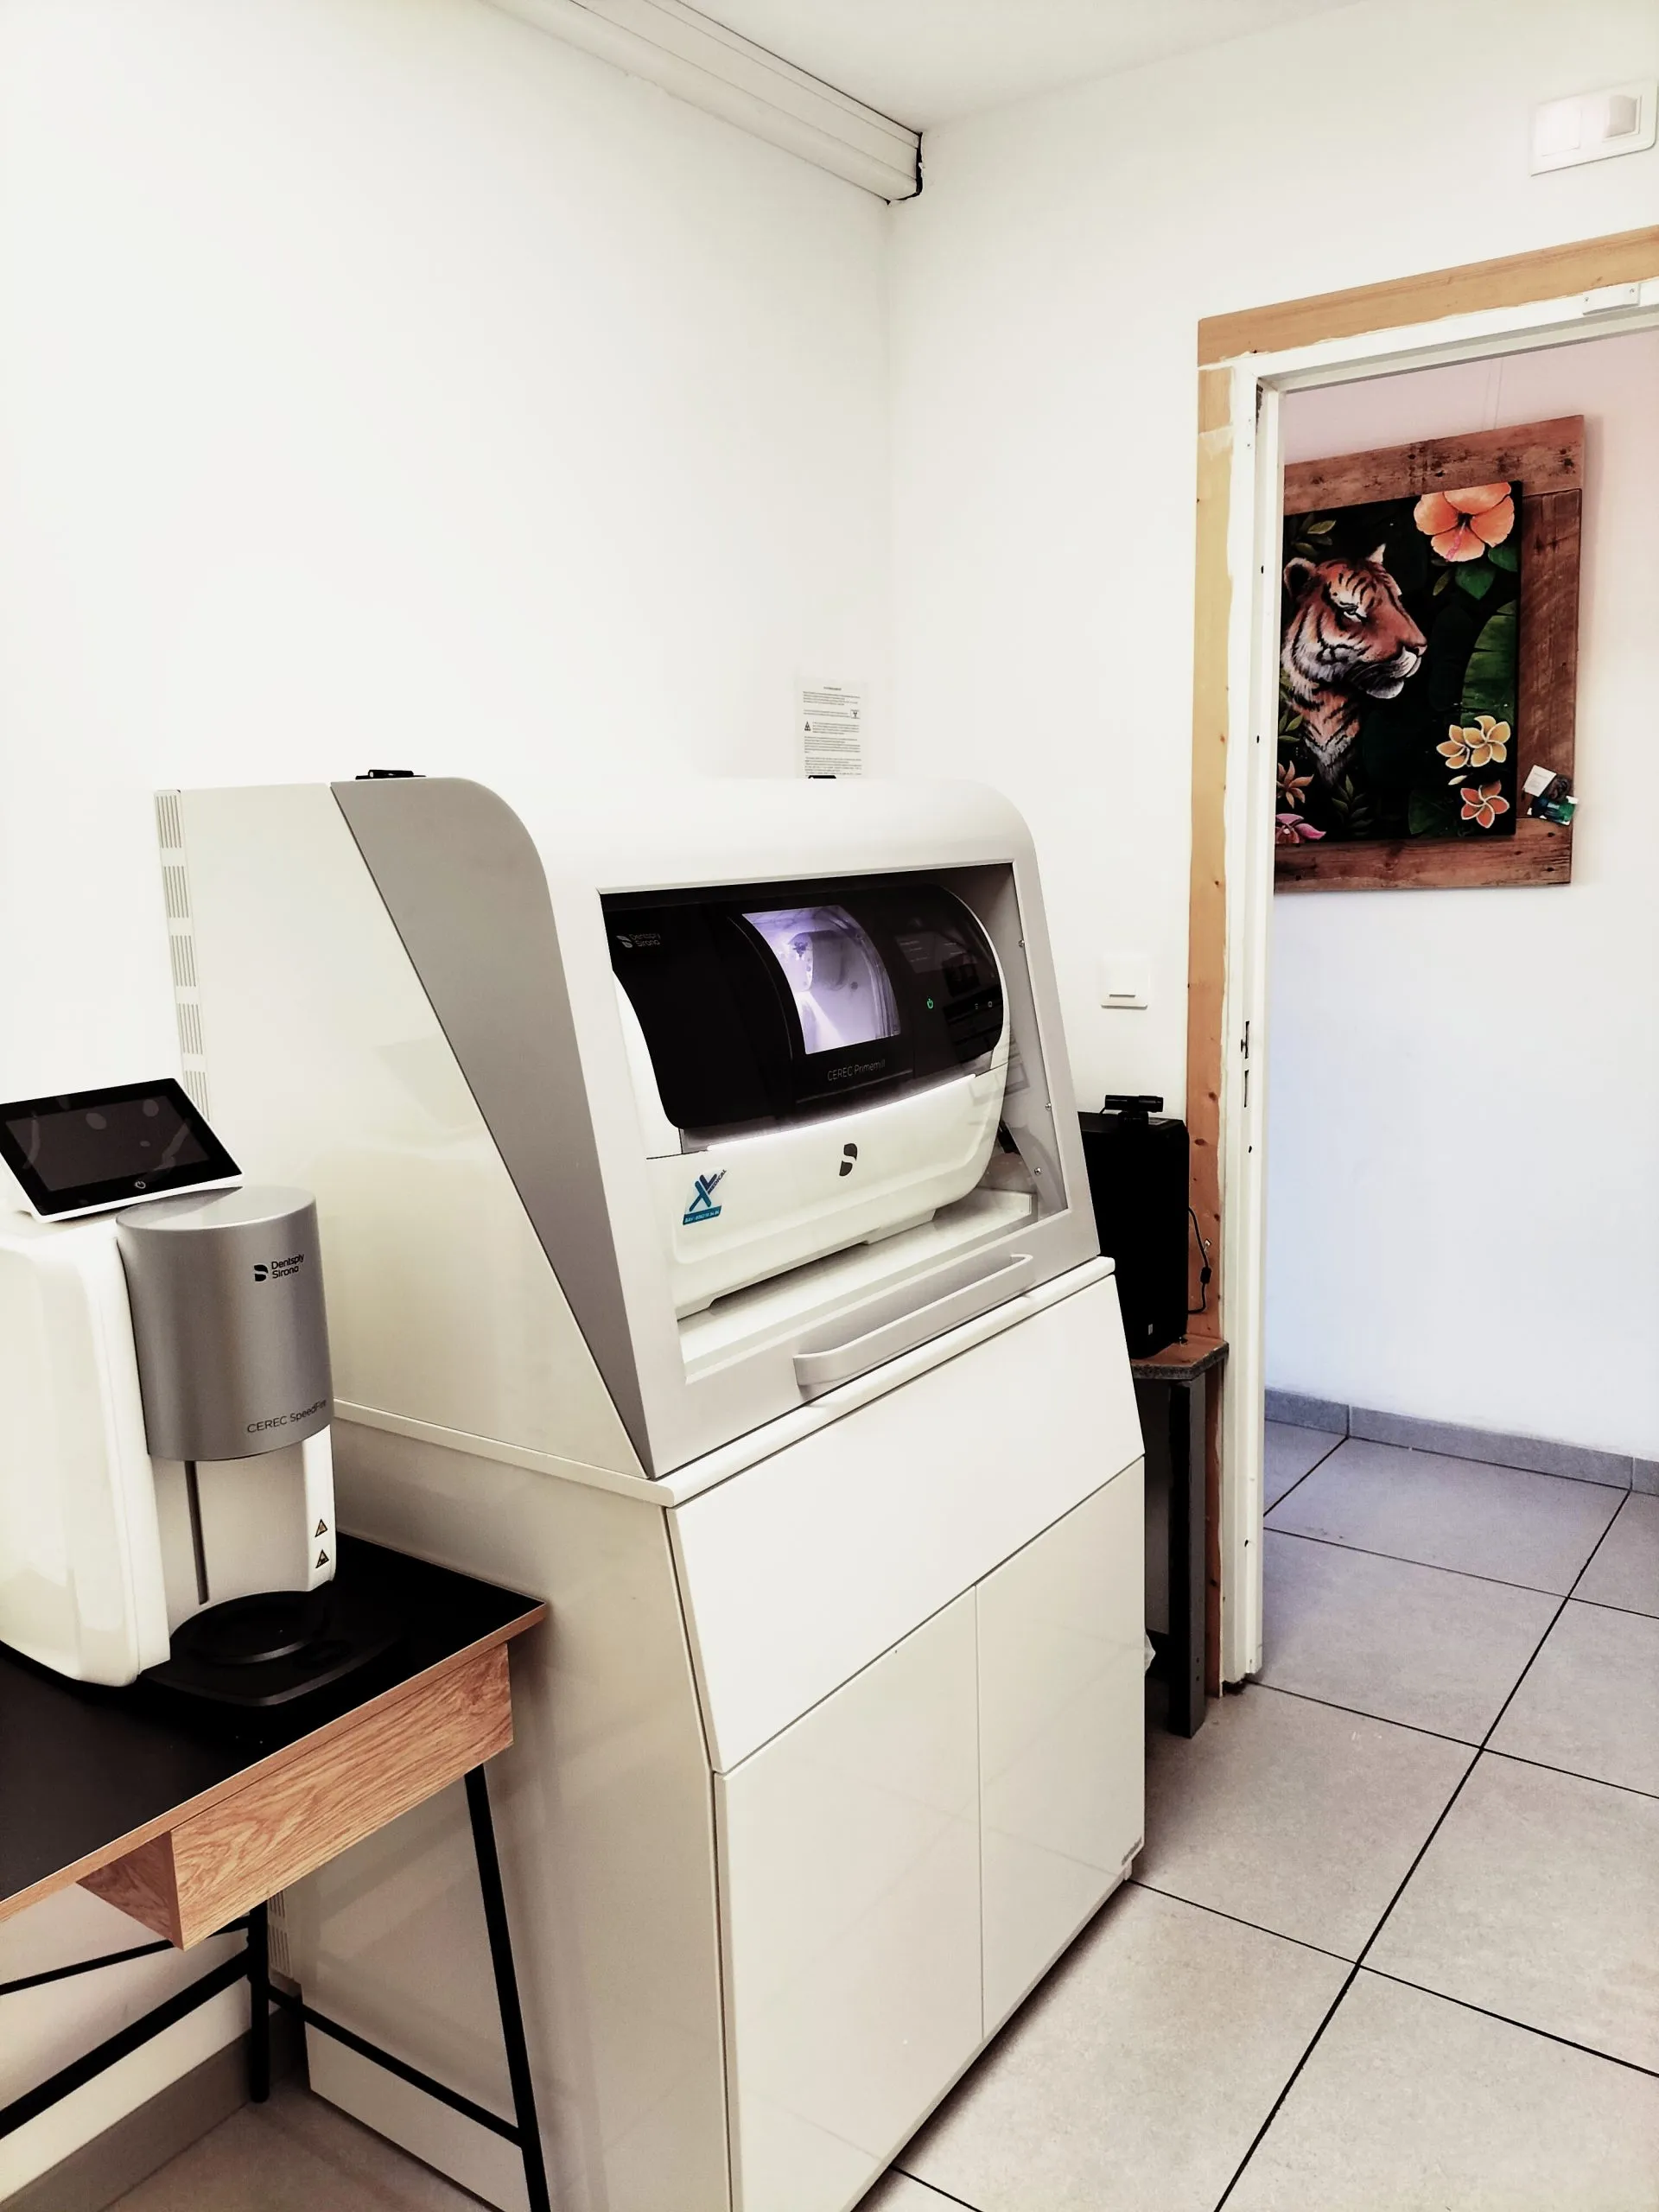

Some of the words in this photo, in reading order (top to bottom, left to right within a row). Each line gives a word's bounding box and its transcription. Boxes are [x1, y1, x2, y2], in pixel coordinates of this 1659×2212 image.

[827, 1065, 853, 1081] CEREC
[854, 1059, 886, 1073] Primemill
[271, 1254, 304, 1269] Dentsply
[272, 1266, 299, 1279] Sirona
[247, 1415, 287, 1433] CEREC
